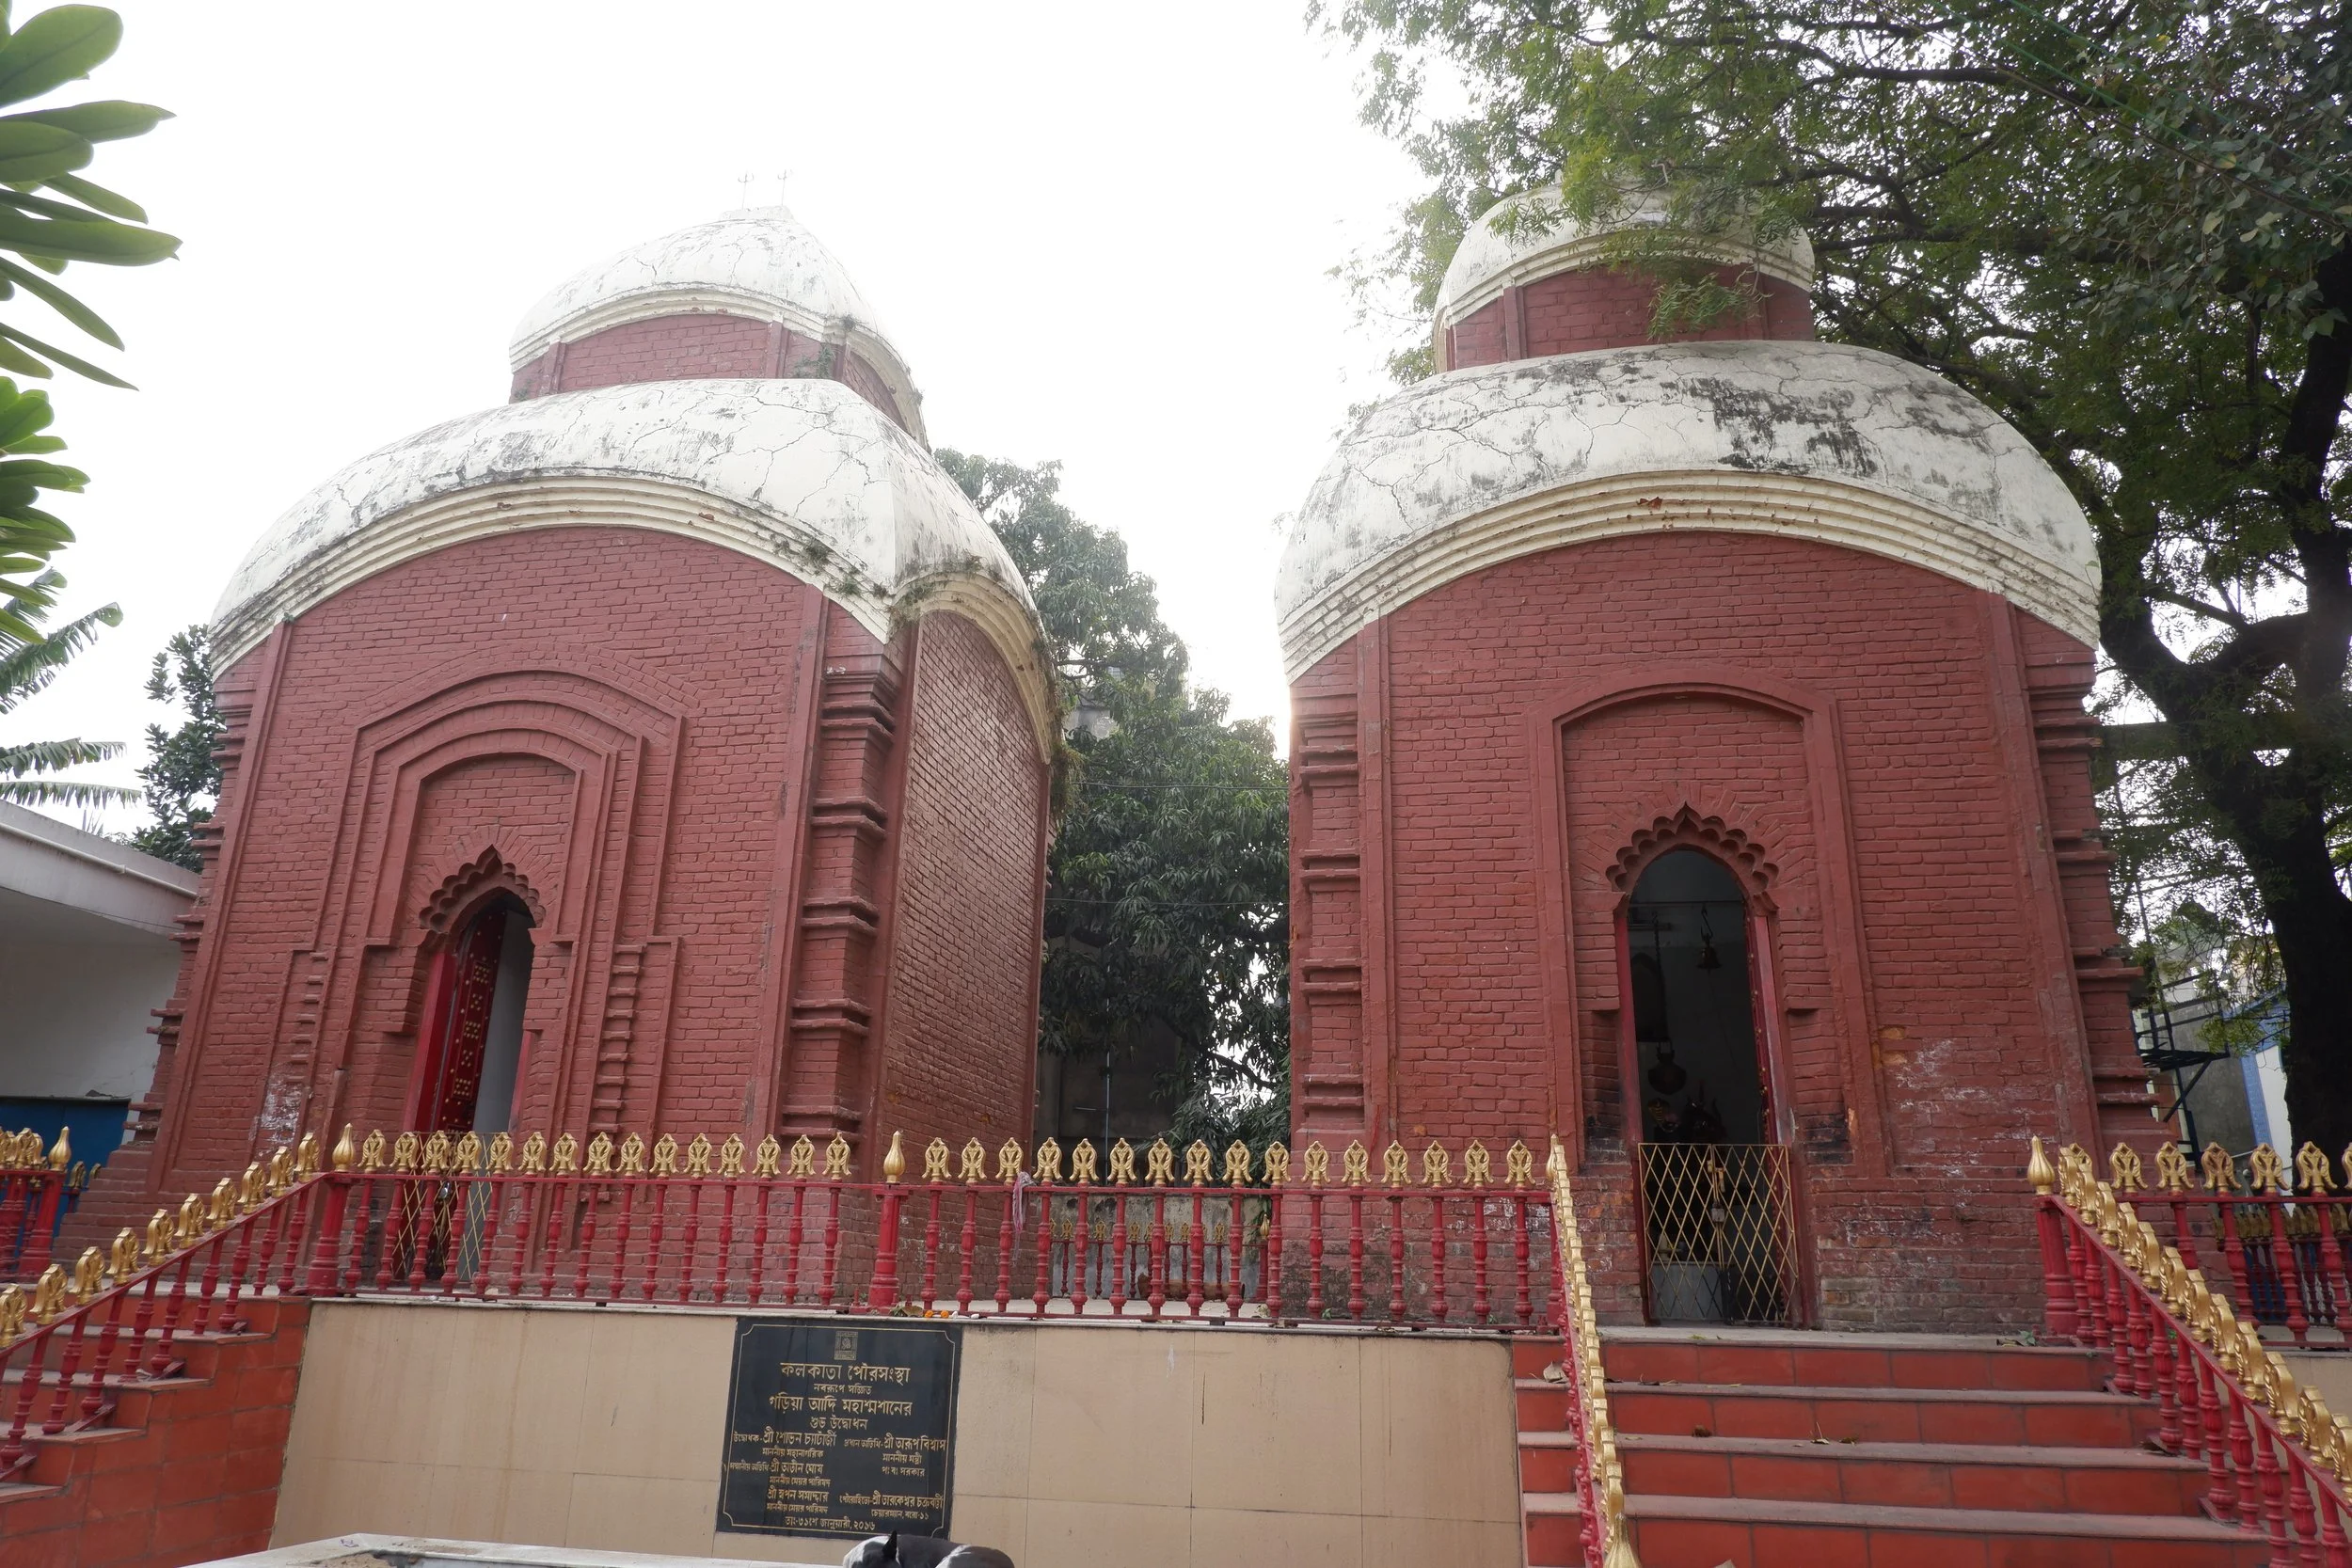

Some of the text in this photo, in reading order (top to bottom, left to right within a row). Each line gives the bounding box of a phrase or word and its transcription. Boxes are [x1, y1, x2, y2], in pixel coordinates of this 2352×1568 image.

[780, 1362, 911, 1386] কলকাতা পৌরসংস্থা
[769, 1391, 803, 1414] গড়িয়া
[808, 1395, 837, 1412] আদি
[810, 1416, 826, 1429] শুভ
